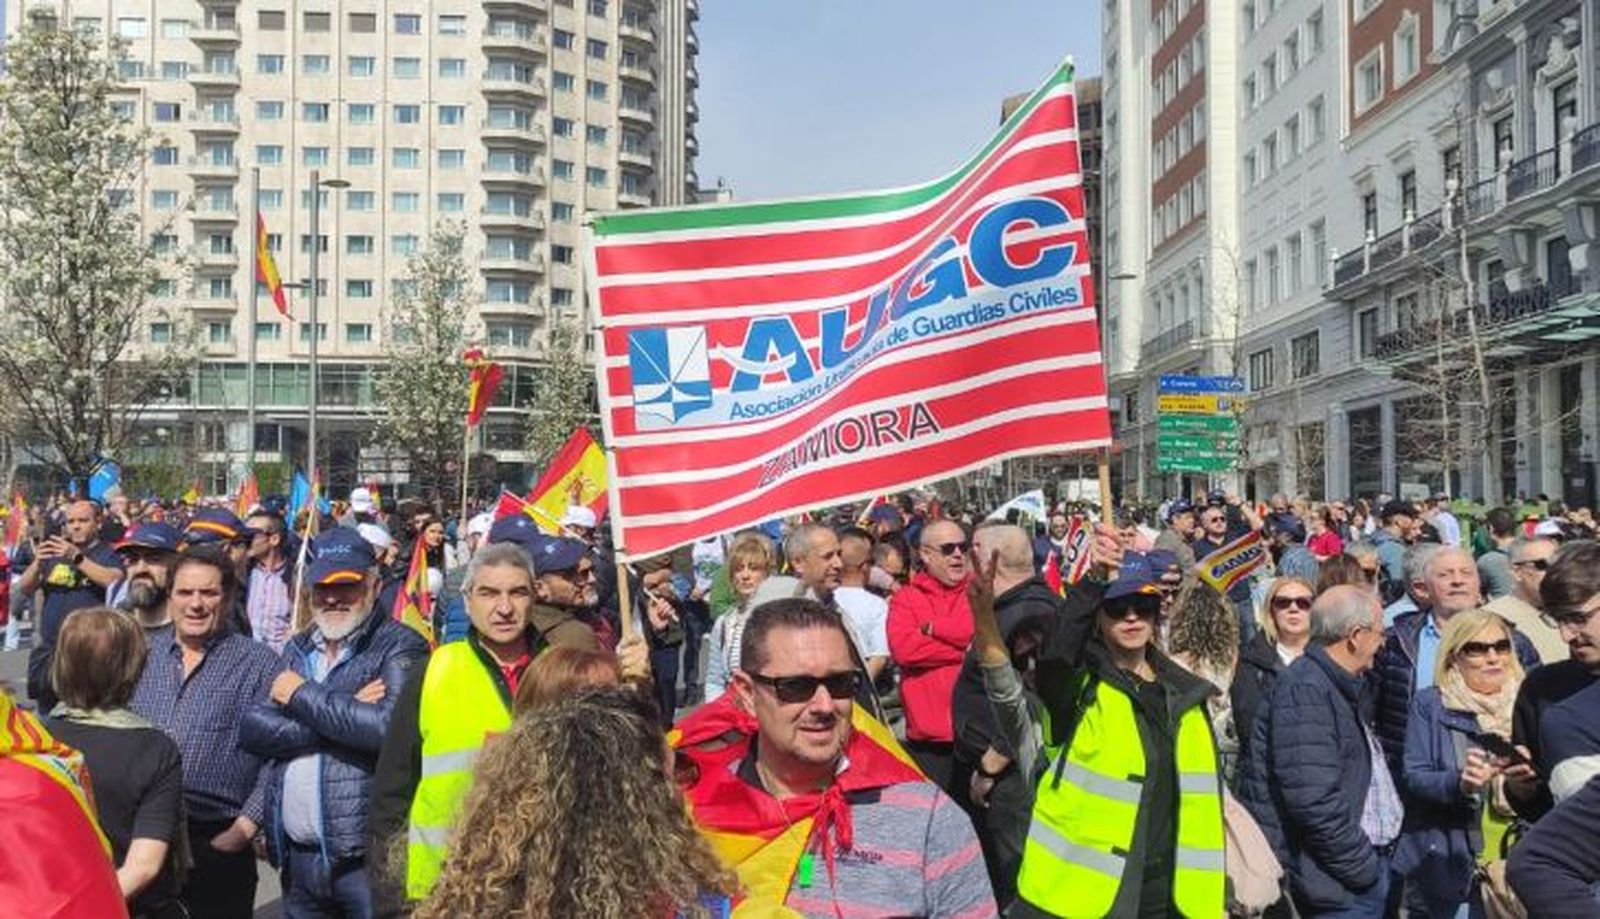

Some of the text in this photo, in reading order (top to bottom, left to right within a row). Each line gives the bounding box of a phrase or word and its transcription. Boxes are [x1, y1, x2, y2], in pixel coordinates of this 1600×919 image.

[730, 384, 824, 420] Asociación
[886, 325, 909, 347] de
[911, 302, 1005, 337] Guardias
[1010, 286, 1079, 314] Civiles
[731, 197, 1077, 393] AUGC
[757, 401, 940, 489] ZAMORA
